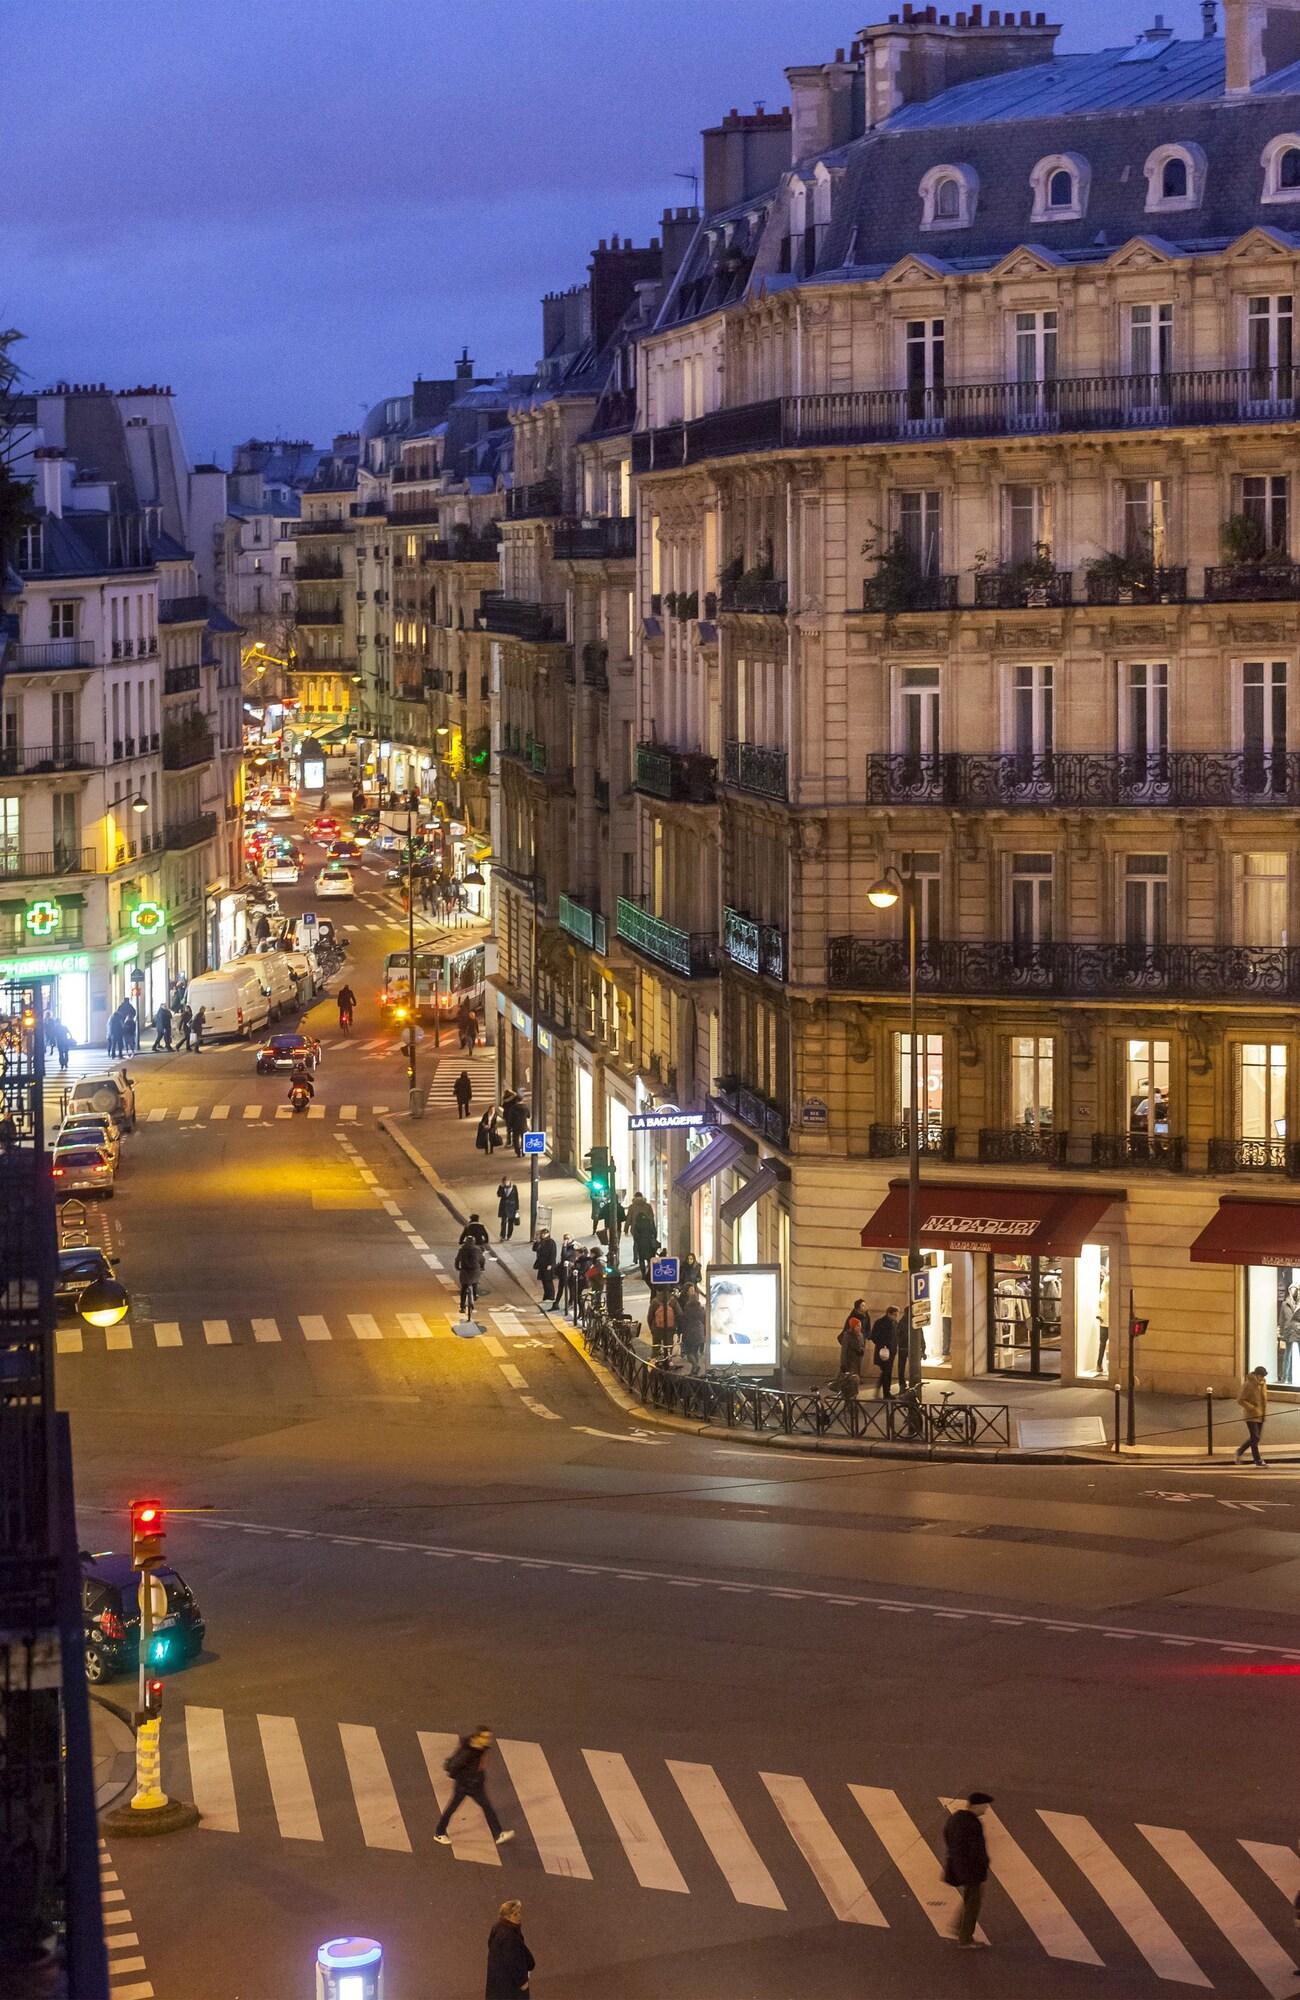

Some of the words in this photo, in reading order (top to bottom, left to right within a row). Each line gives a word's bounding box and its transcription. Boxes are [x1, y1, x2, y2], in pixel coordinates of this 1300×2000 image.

[631, 1118, 645, 1128] LA
[647, 1115, 703, 1127] BAGAGERIE
[917, 1278, 926, 1296] P
